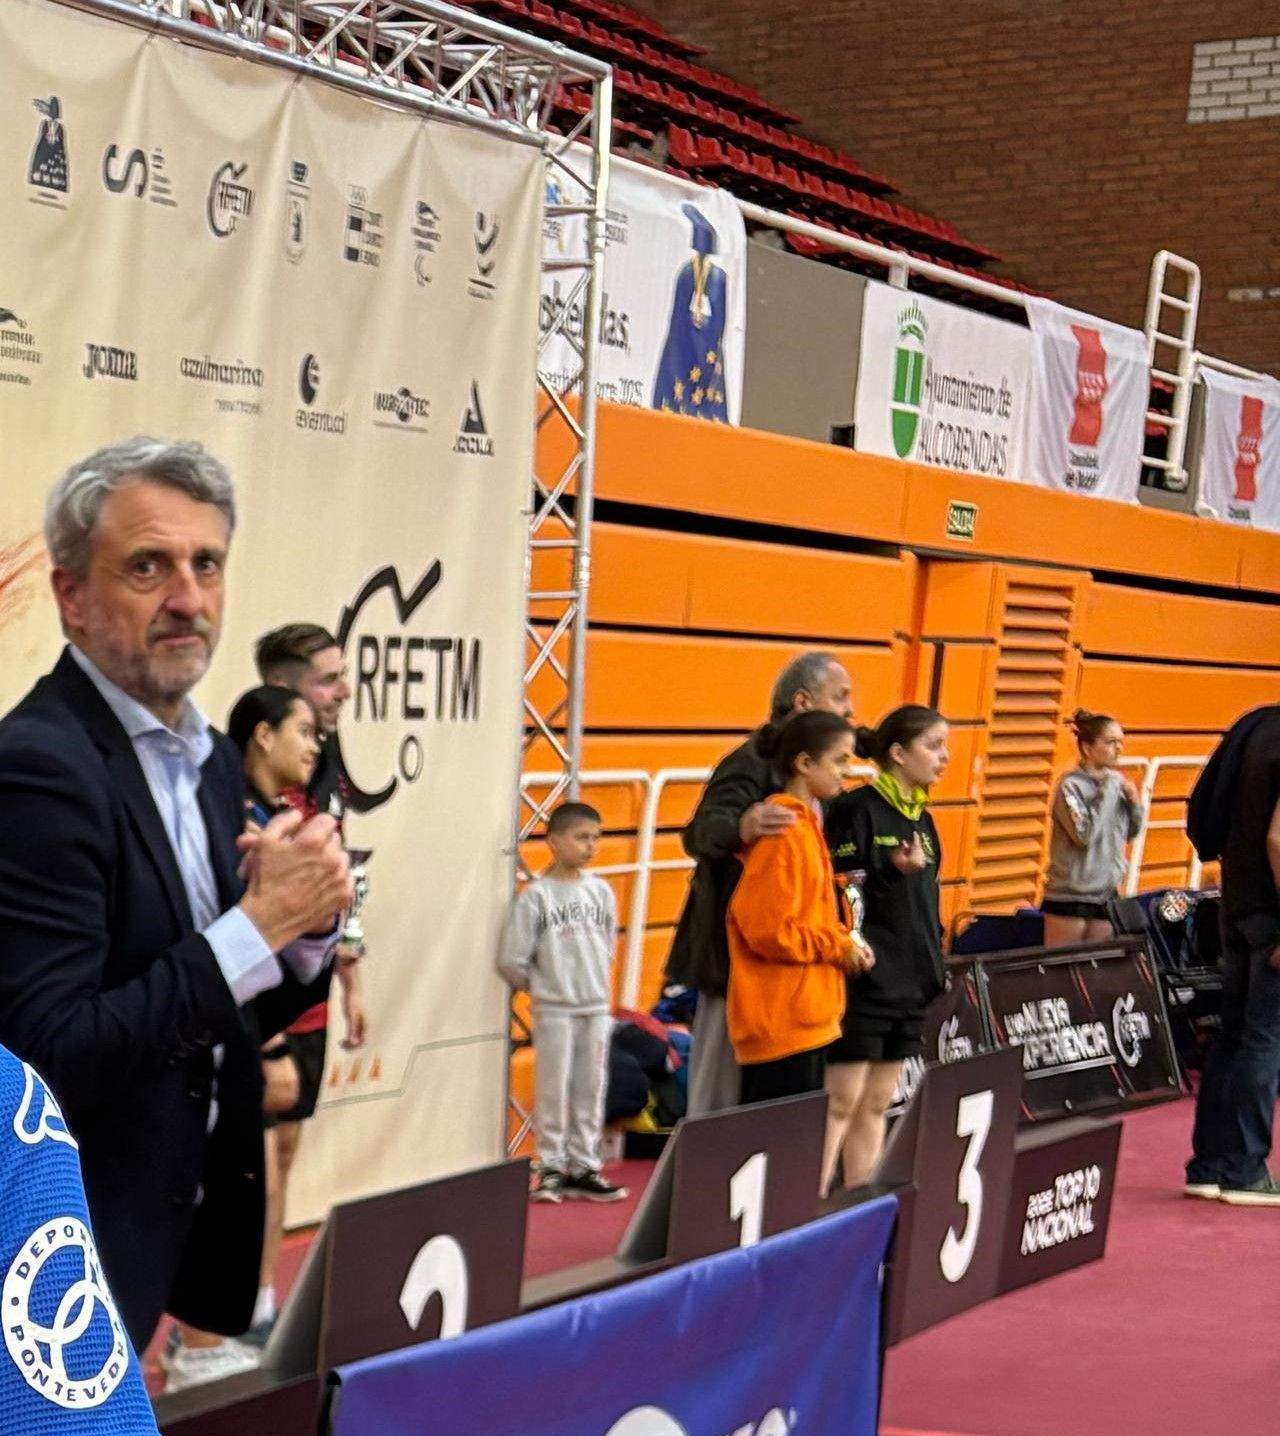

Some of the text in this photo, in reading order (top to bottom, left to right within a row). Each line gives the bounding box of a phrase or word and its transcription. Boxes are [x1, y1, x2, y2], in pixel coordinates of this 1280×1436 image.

[355, 636, 480, 722] RFETM
[940, 1090, 994, 1283] 3
[1054, 1169, 1084, 1209] TOP
[1021, 1200, 1094, 1255] NACIONAL
